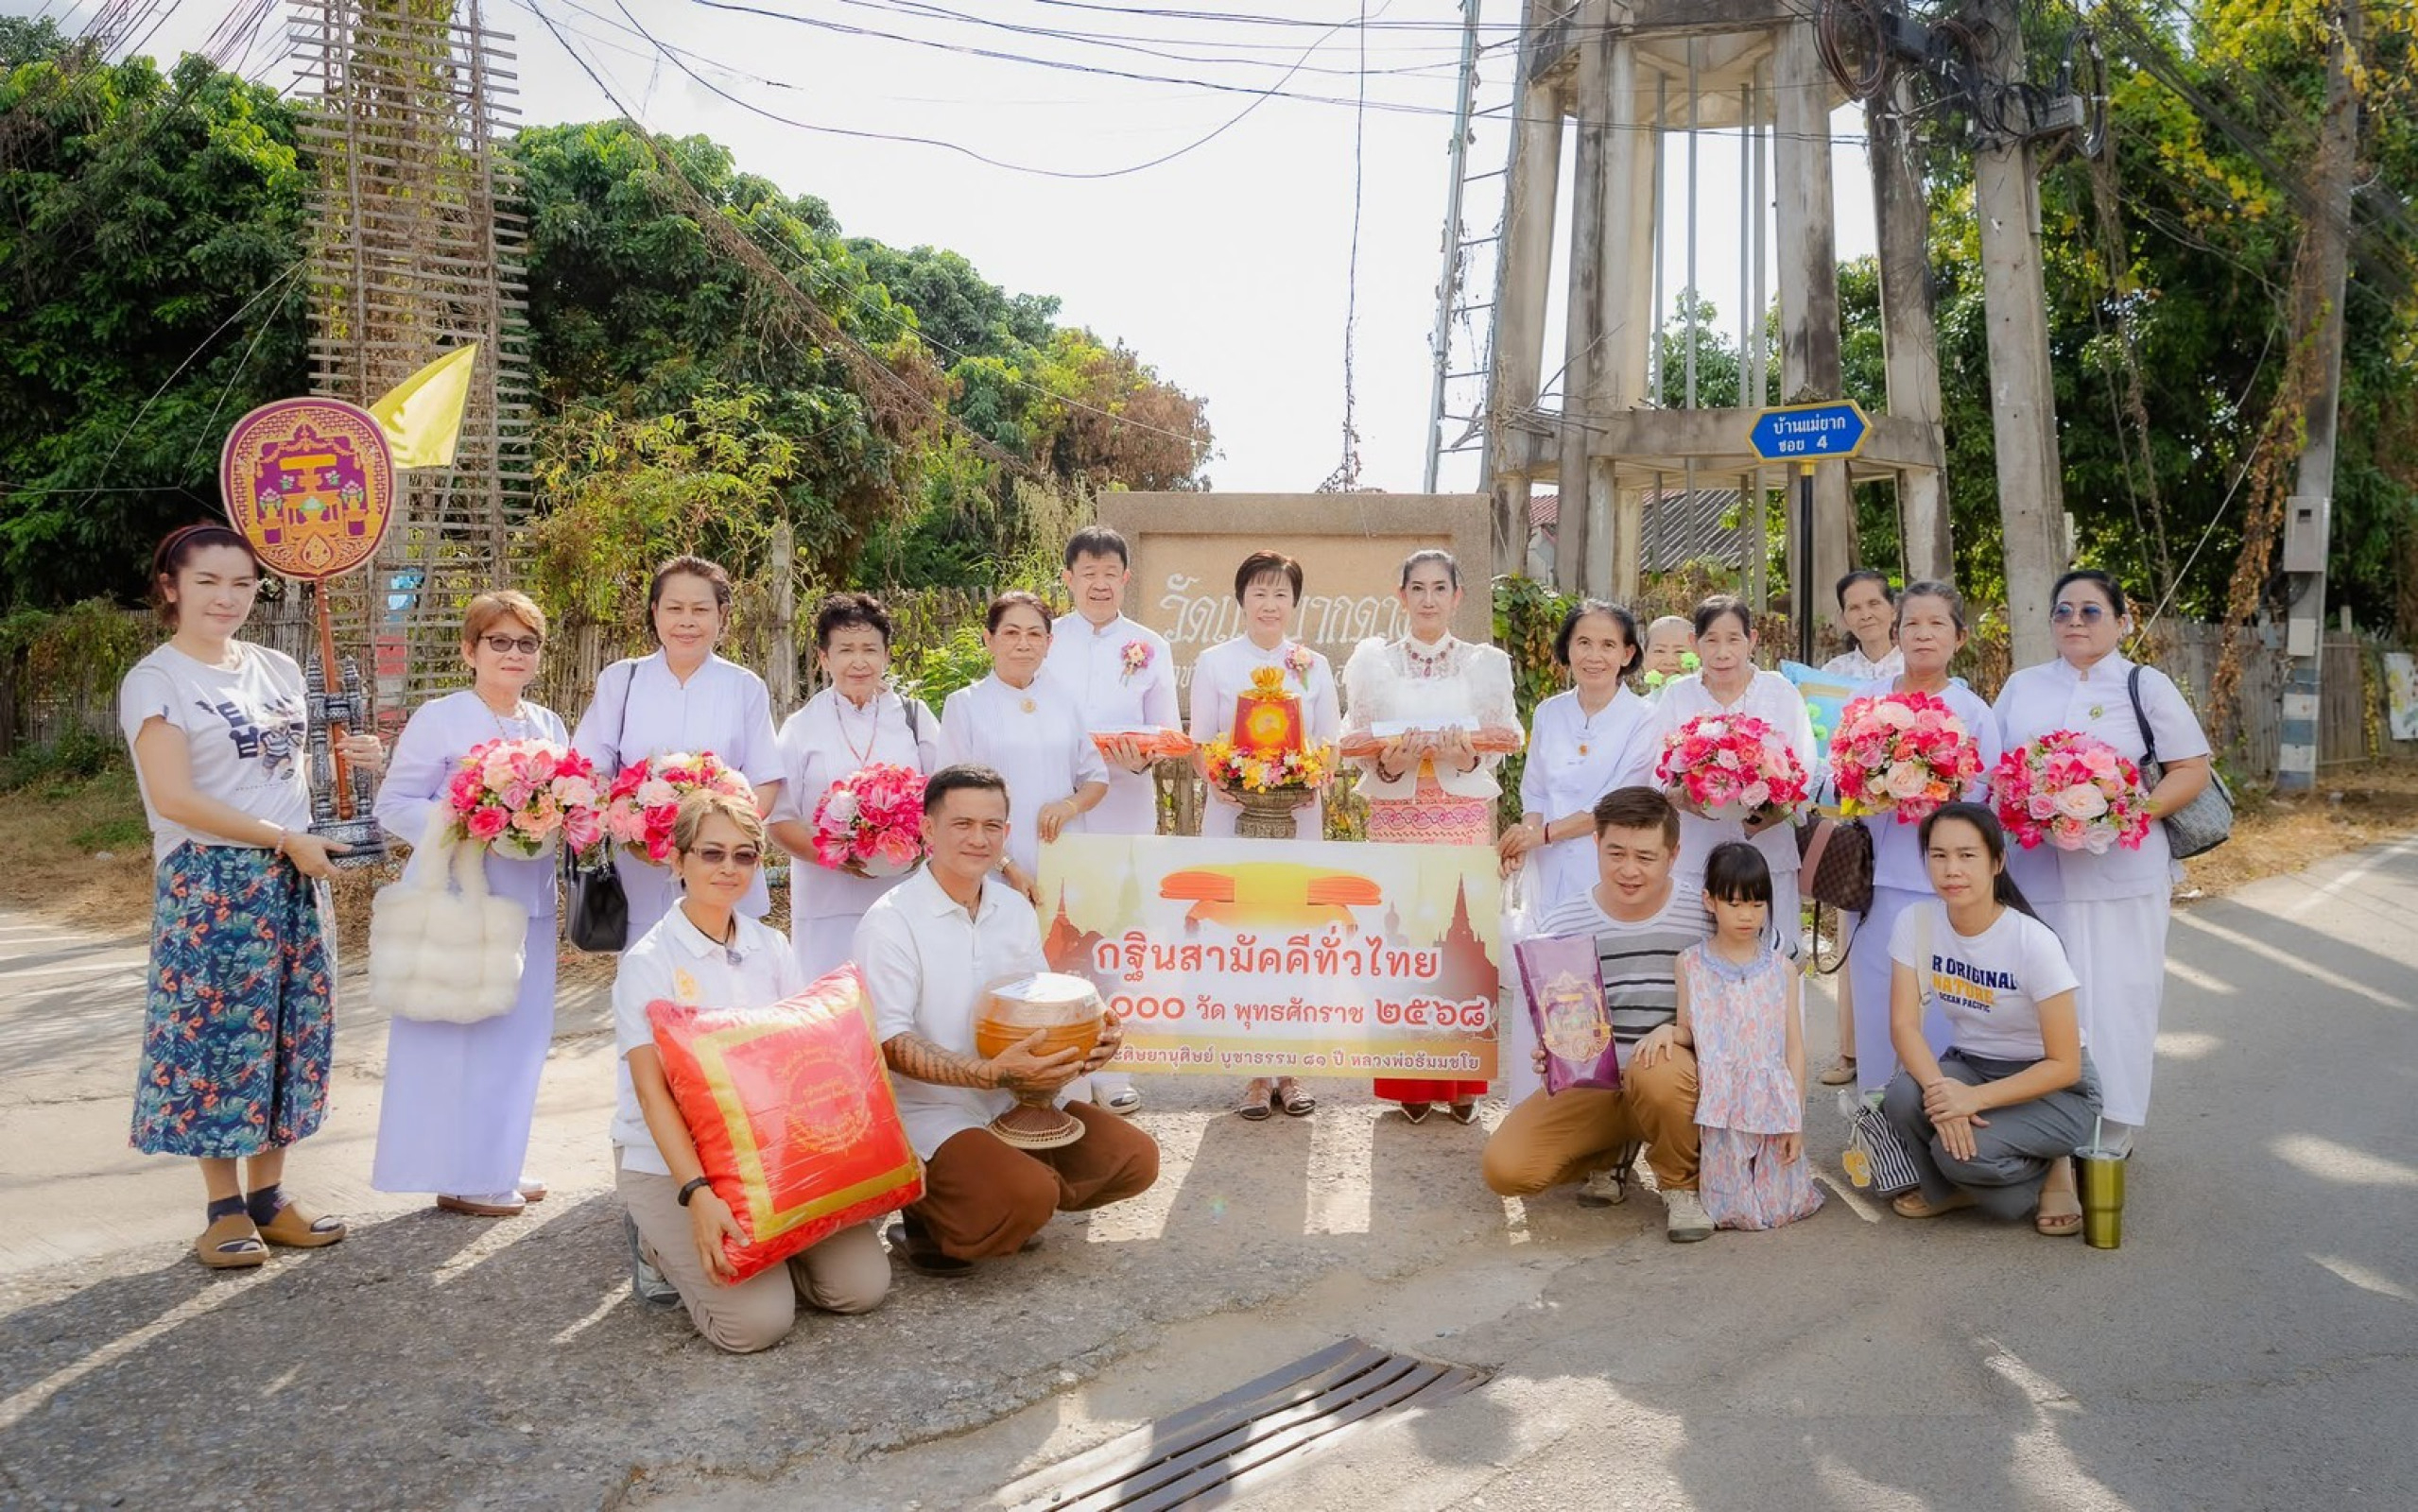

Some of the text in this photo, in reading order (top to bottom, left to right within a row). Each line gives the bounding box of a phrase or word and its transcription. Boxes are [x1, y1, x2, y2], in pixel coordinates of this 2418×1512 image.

[1772, 413, 1846, 435] บ้านแม่ยาก
[1778, 434, 1829, 453] ซอย 4
[1097, 925, 1438, 982] กฐินสามัคคีทั่วไทย
[1945, 956, 2017, 990] ORIGINAL
[1938, 991, 1961, 1005] OCEAN
[1196, 995, 1225, 1021] วัด
[1235, 997, 1364, 1030] พุทธศักราช
[1375, 998, 1485, 1027] ๒๕๖๘
[1112, 1044, 1215, 1068] ะศิษยานุศิษย์
[1220, 1050, 1297, 1070] บูชาธรรม
[1333, 1048, 1344, 1066] ปี
